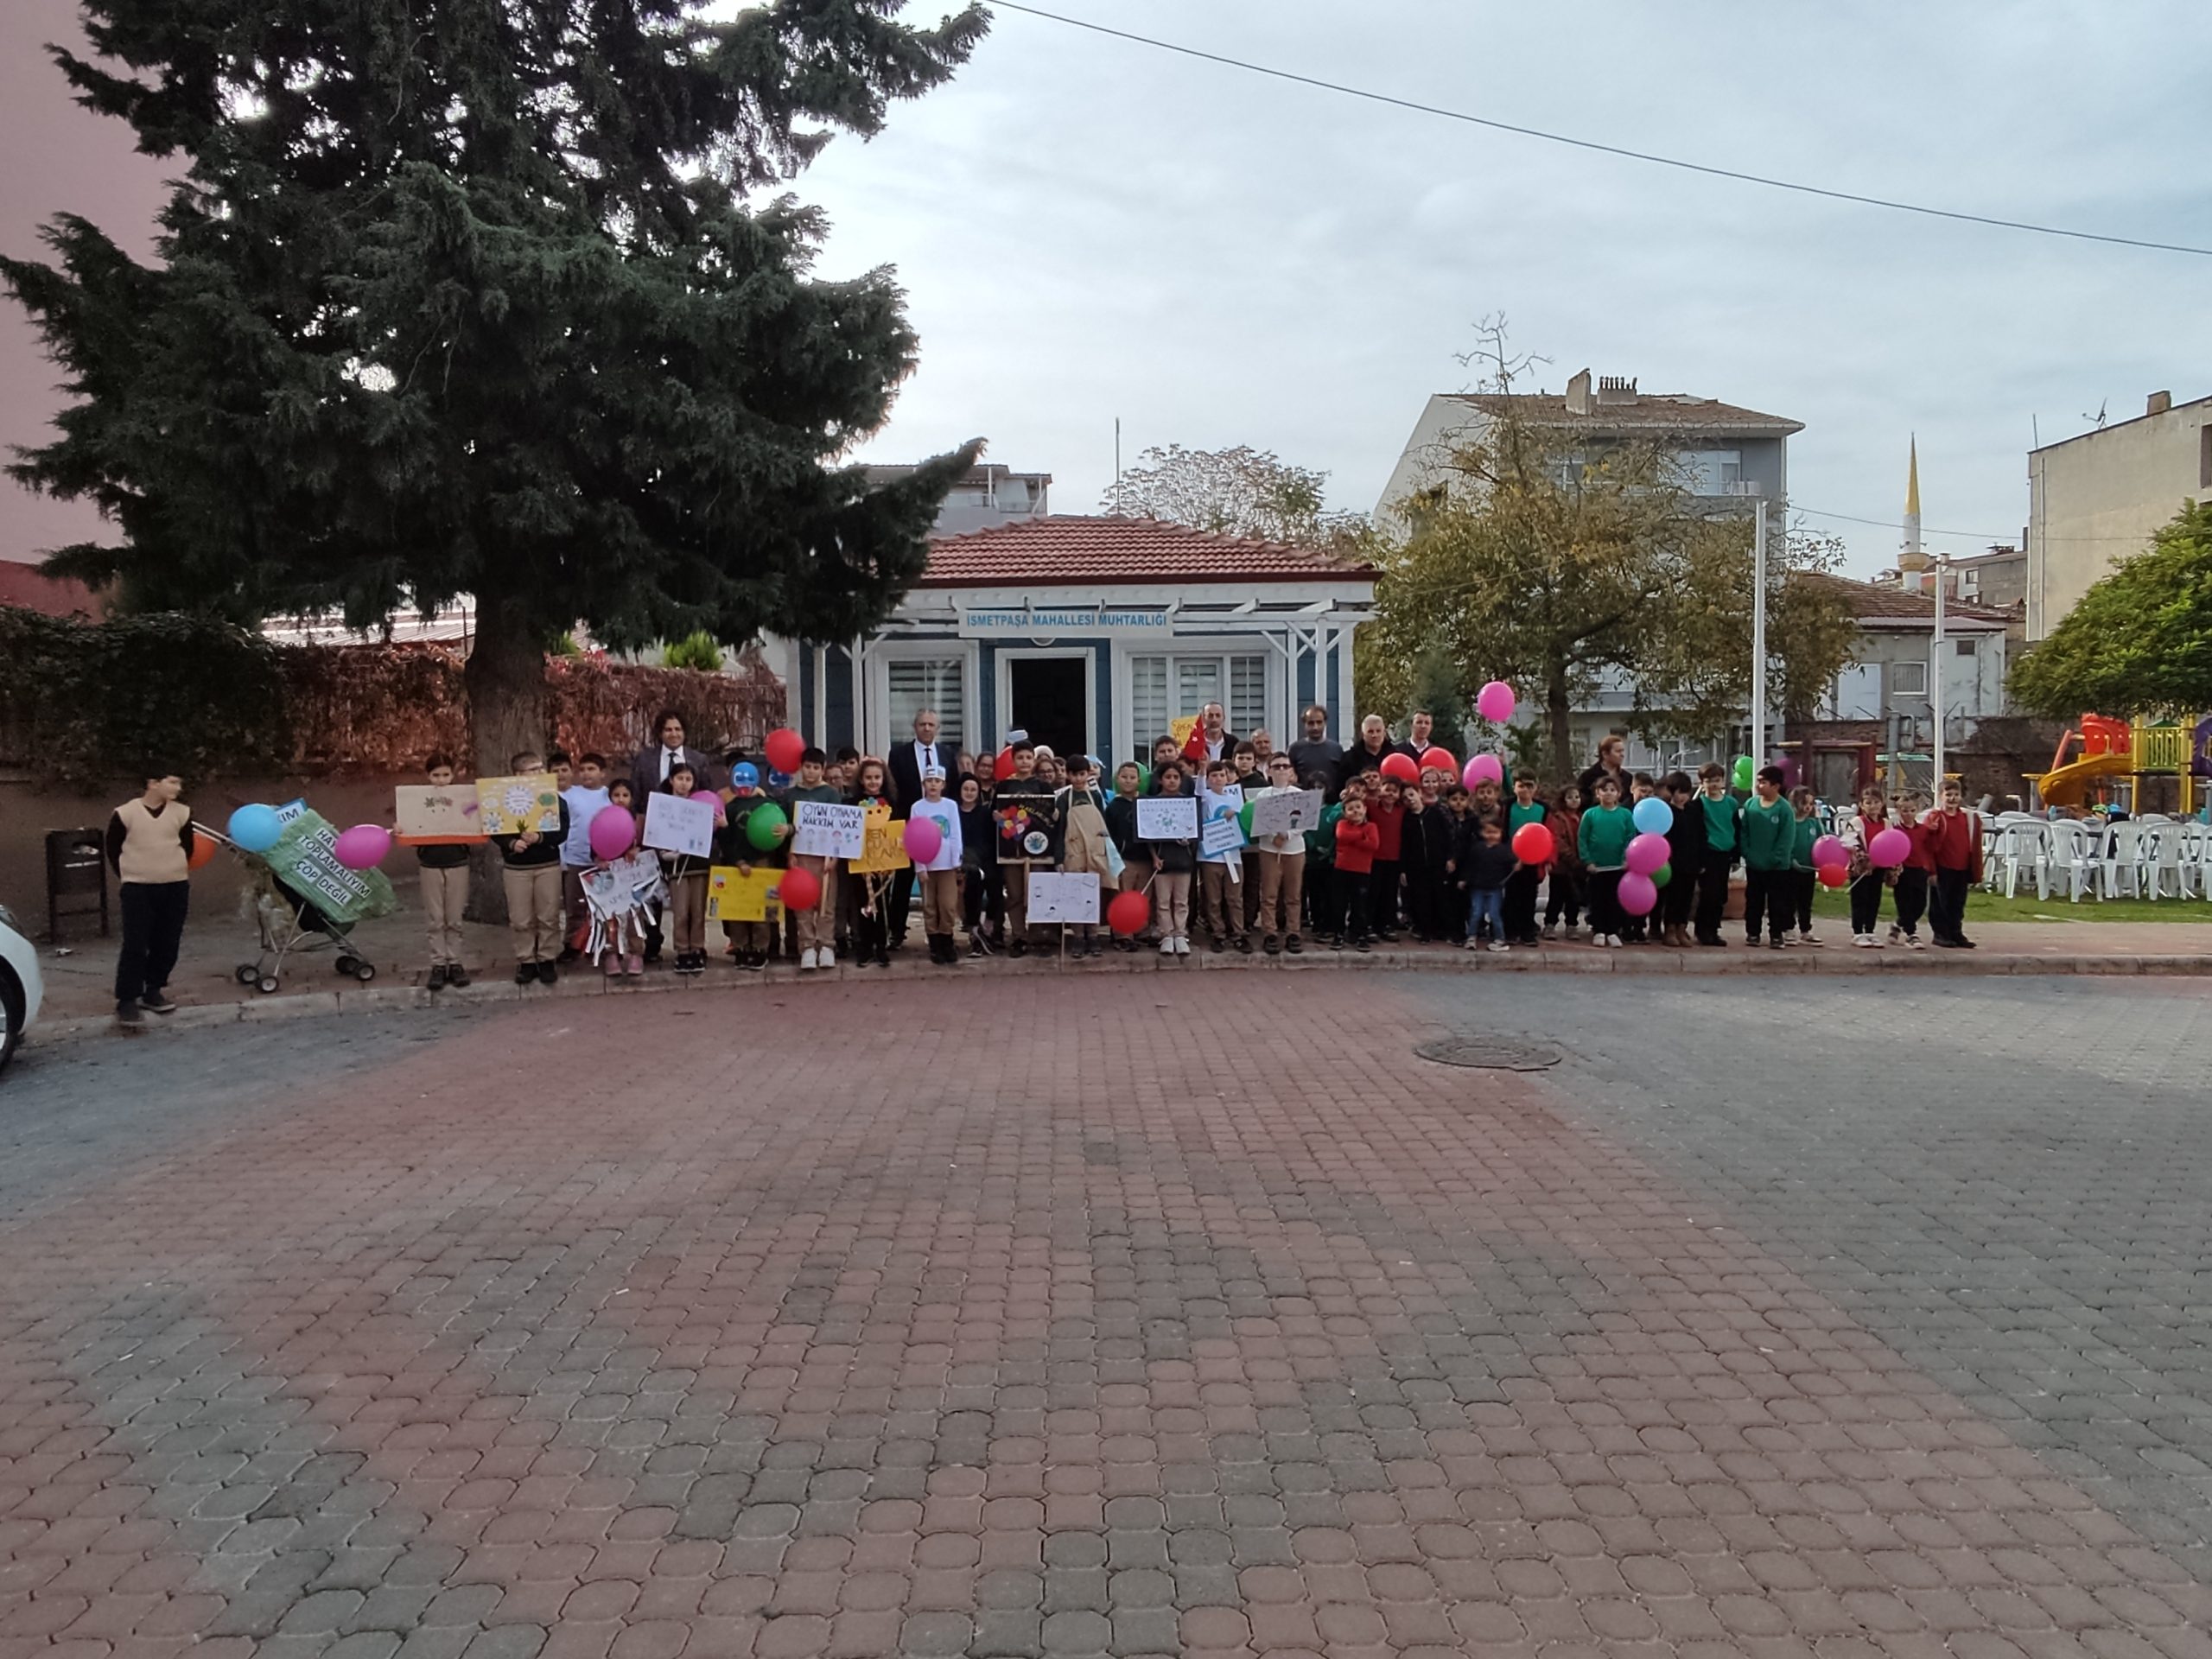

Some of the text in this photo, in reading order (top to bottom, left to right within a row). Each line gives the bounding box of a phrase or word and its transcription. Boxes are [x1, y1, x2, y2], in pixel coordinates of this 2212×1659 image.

[967, 612, 1166, 628] İSMETPAŞA MAHALLESİ MUHTARLIĞI
[802, 816, 859, 830] HAKKIM VAR
[301, 836, 372, 898] TOPLAMALIYIM
[296, 861, 350, 905] ÇÖP DEĞİL
